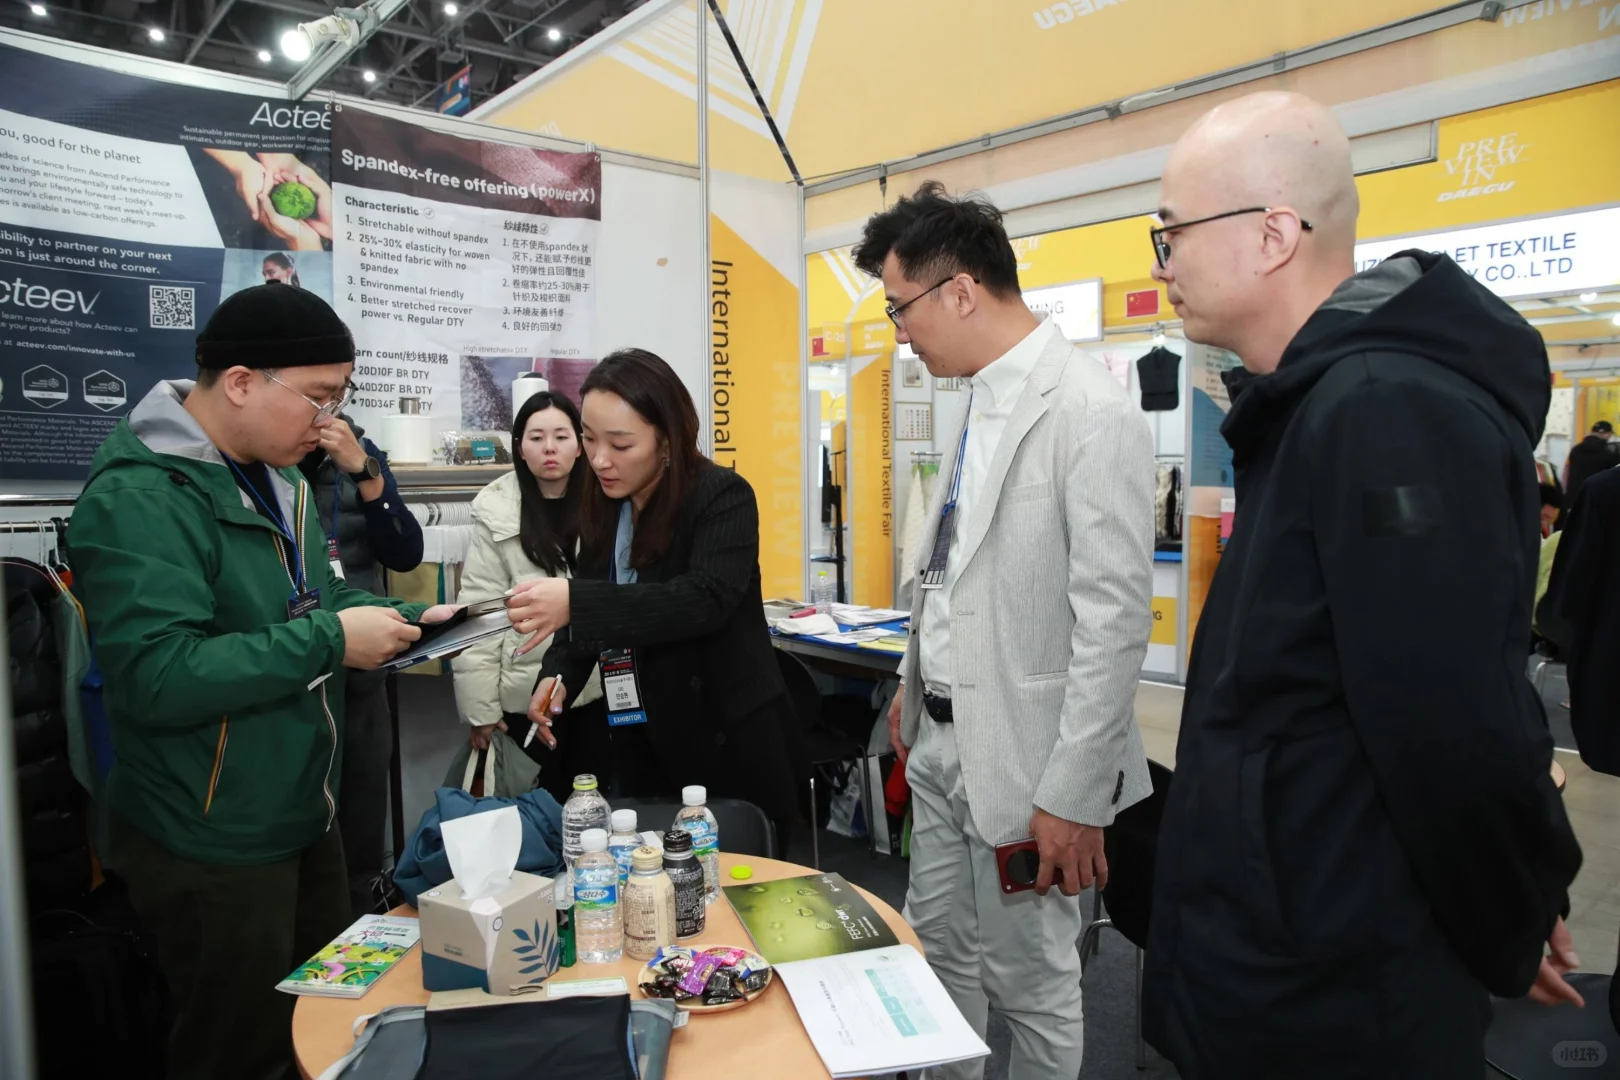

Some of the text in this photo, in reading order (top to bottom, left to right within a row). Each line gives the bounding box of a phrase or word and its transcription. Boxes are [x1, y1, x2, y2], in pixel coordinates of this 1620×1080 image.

[183, 125, 222, 137] Sustainable
[224, 130, 260, 141] permanent
[262, 134, 296, 142] protection
[216, 138, 242, 147] outdoor
[244, 142, 260, 150] gear,
[23, 134, 55, 148] good
[58, 139, 77, 152] for
[80, 144, 100, 156] the
[104, 150, 142, 164] planet
[32, 158, 64, 170] science
[66, 164, 87, 174] from
[88, 168, 120, 181] Ascend
[121, 174, 171, 187] Performance
[342, 148, 460, 188] Spandex-free
[9, 177, 154, 206] and your lifestyle forward today's
[12, 164, 41, 177] brings
[43, 172, 110, 190] environmentally
[111, 182, 128, 192] safe
[130, 184, 173, 200] technology
[174, 192, 184, 200] to
[1437, 181, 1517, 202] DAEGU
[22, 202, 59, 213] available
[72, 208, 119, 222] low-carbon
[121, 216, 157, 228] offerings.
[38, 192, 62, 202] client
[104, 204, 122, 212] next
[124, 206, 150, 216] week's
[152, 210, 187, 220] meet-up.
[345, 196, 419, 216] Characteristic
[346, 214, 489, 244] 1. Stretchable without spandex
[504, 221, 538, 234] 纱线特性
[38, 237, 52, 246] to
[55, 240, 99, 252] partner
[102, 246, 117, 254] on
[120, 247, 144, 258] your
[148, 251, 172, 262] next
[346, 231, 354, 242] 2.
[406, 240, 446, 256] elasticity
[449, 247, 462, 257] for
[464, 252, 490, 260] woven
[1487, 232, 1578, 259] TEXTILE
[16, 247, 26, 258] is
[28, 249, 51, 262] just
[54, 254, 96, 267] around
[98, 258, 118, 270] the
[121, 262, 160, 274] corner.
[360, 248, 467, 270] & knitted fabric with no
[360, 262, 399, 276] spandex
[1485, 256, 1574, 284] CO..LTD
[347, 276, 464, 301] 3. Environmental friendly
[347, 293, 473, 315] 4. Better stretched recover
[2, 311, 24, 321] learn
[25, 316, 48, 324] more
[50, 317, 74, 328] about
[75, 320, 92, 329] how
[94, 322, 123, 332] Acteev
[8, 322, 71, 336] your products?
[362, 309, 464, 328] power vs. Regular DTY
[16, 342, 136, 358] acteev.com/innovate-with-us
[712, 260, 736, 452] International
[358, 366, 430, 380] 20D10F BR DTY
[360, 382, 432, 395] 40D20F BR DTY
[360, 398, 432, 410] 70D34F TY
[880, 368, 892, 538] International Textile Fair
[613, 714, 642, 724] EXHIBITOR
